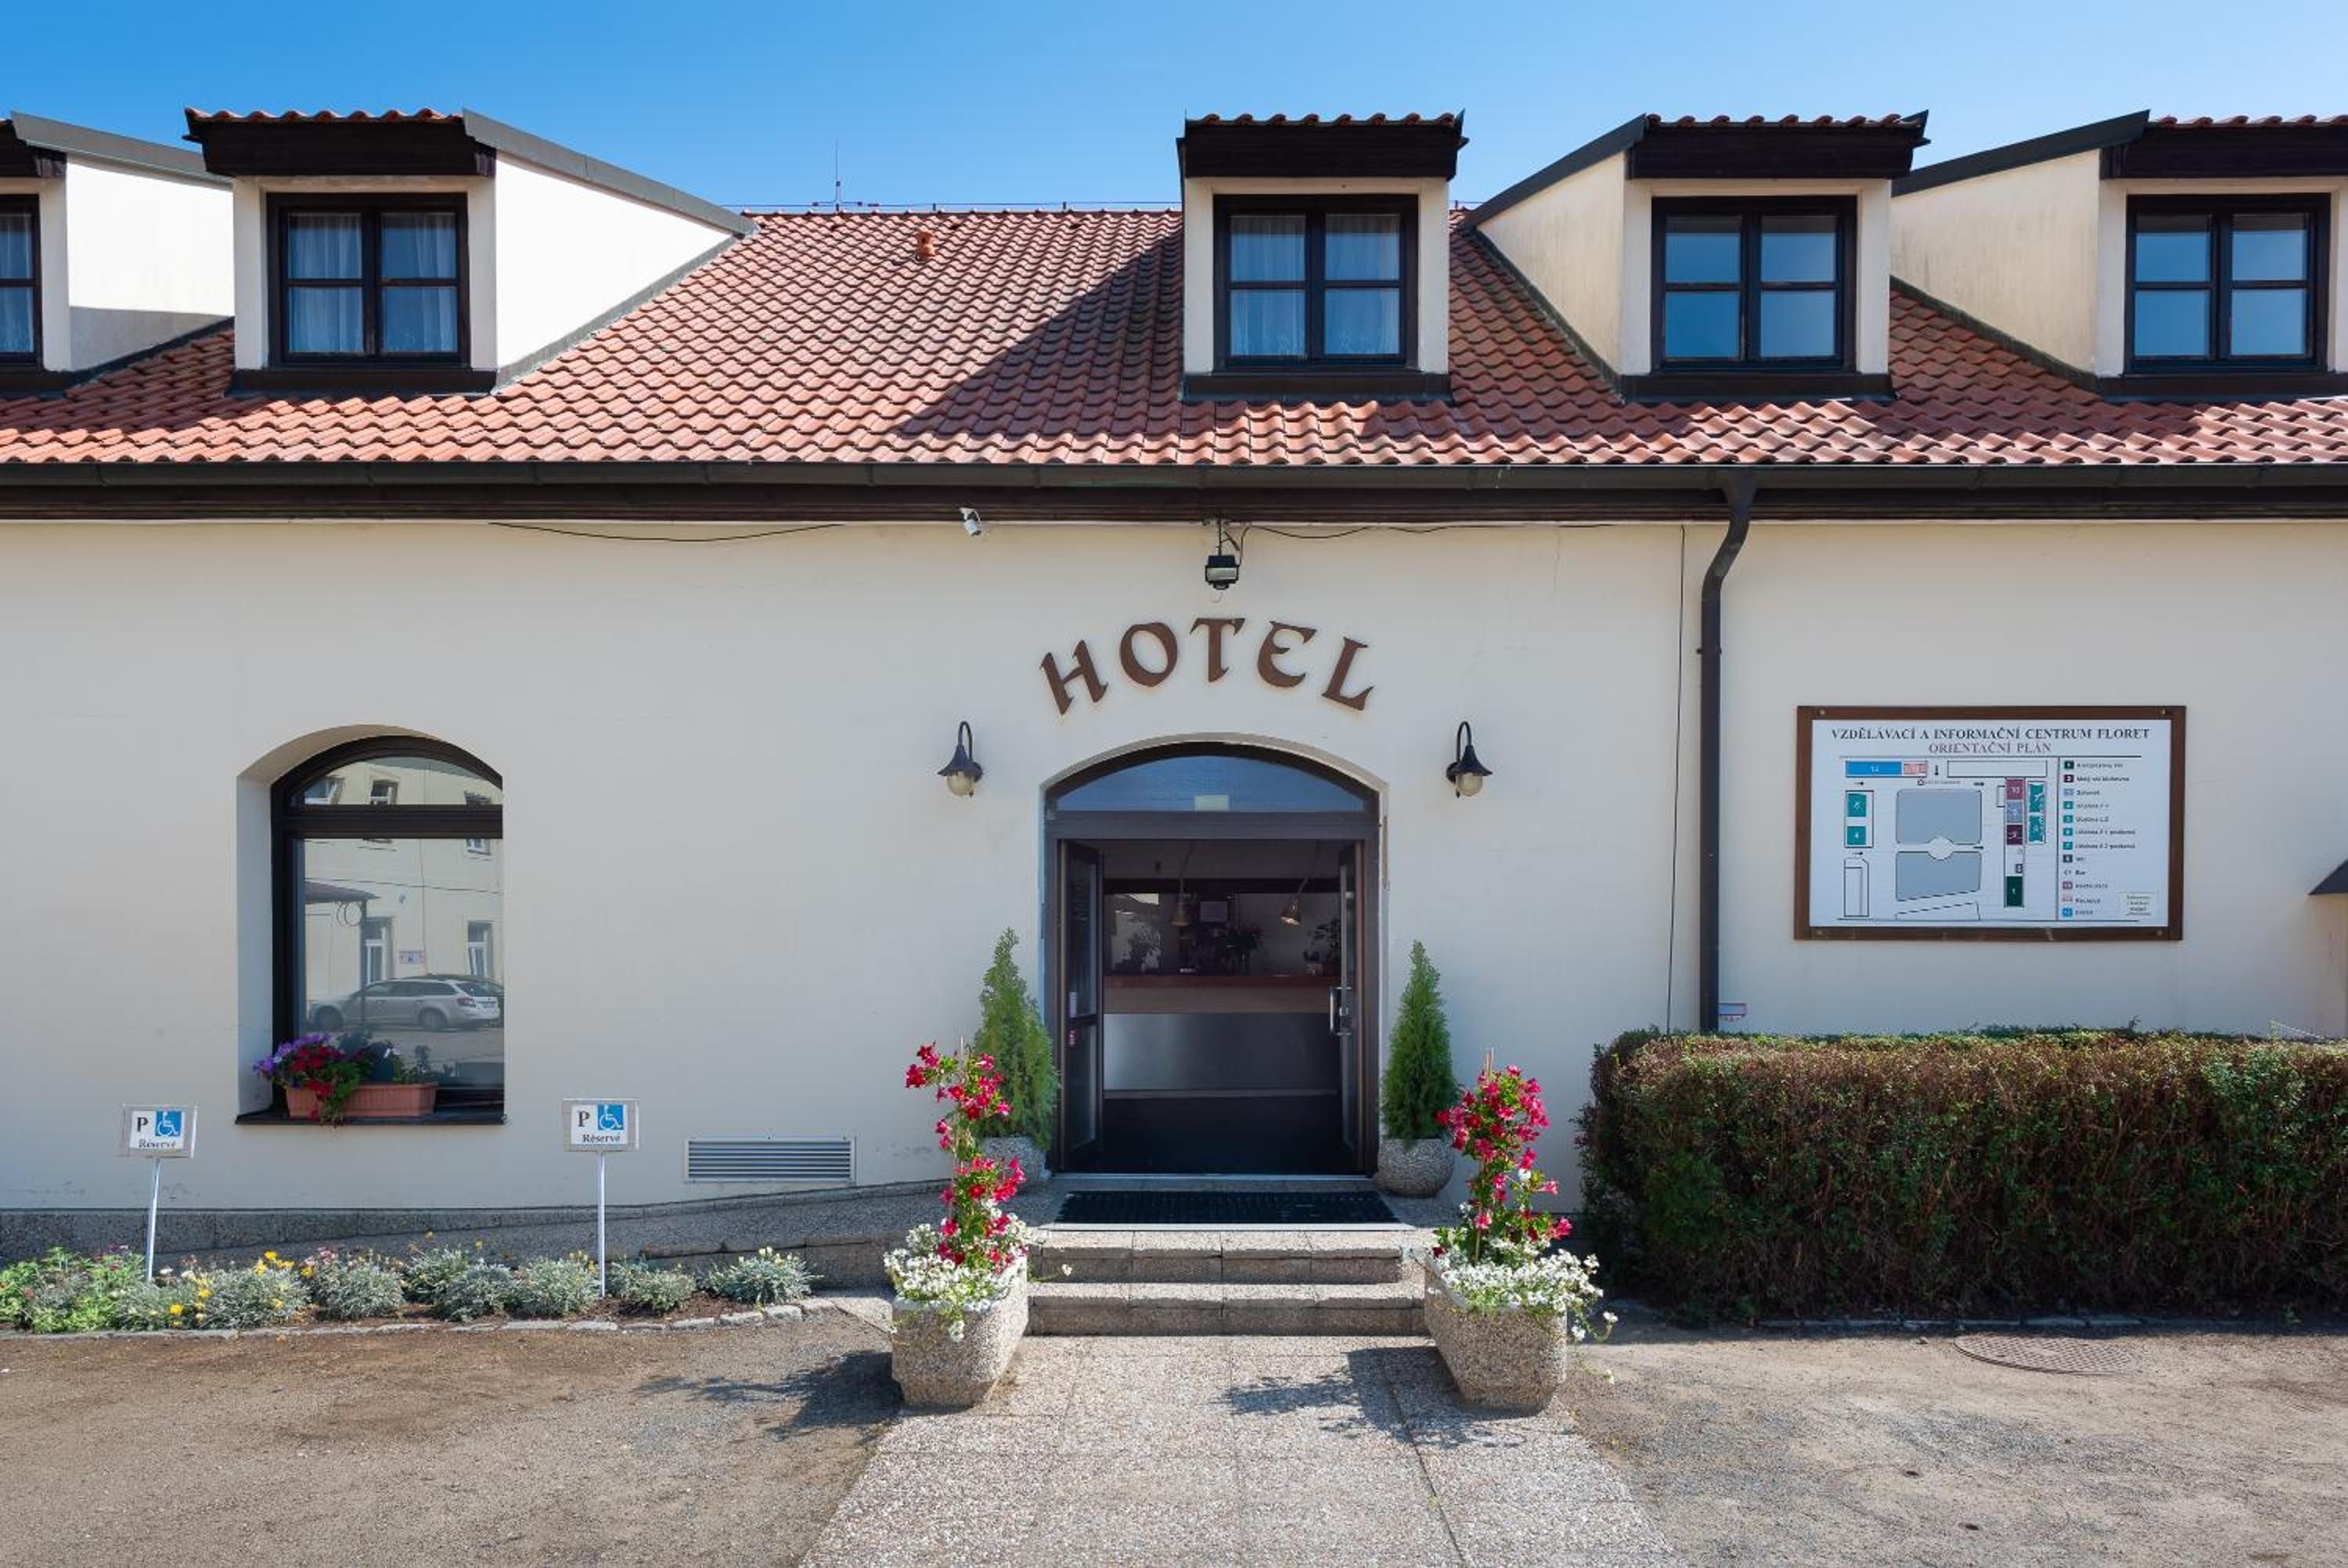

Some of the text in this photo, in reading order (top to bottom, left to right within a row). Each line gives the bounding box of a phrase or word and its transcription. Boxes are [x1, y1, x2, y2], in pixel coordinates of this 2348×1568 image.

[1039, 617, 1374, 716] HOTEL
[1831, 726, 2150, 739] VZDĚLÁVACÍ A INFORMAČNÍ CENTRUM FLORET
[1928, 741, 2052, 753] ORIENTAČNÍ PLÁN
[137, 1117, 149, 1132] P
[578, 1110, 591, 1127] P
